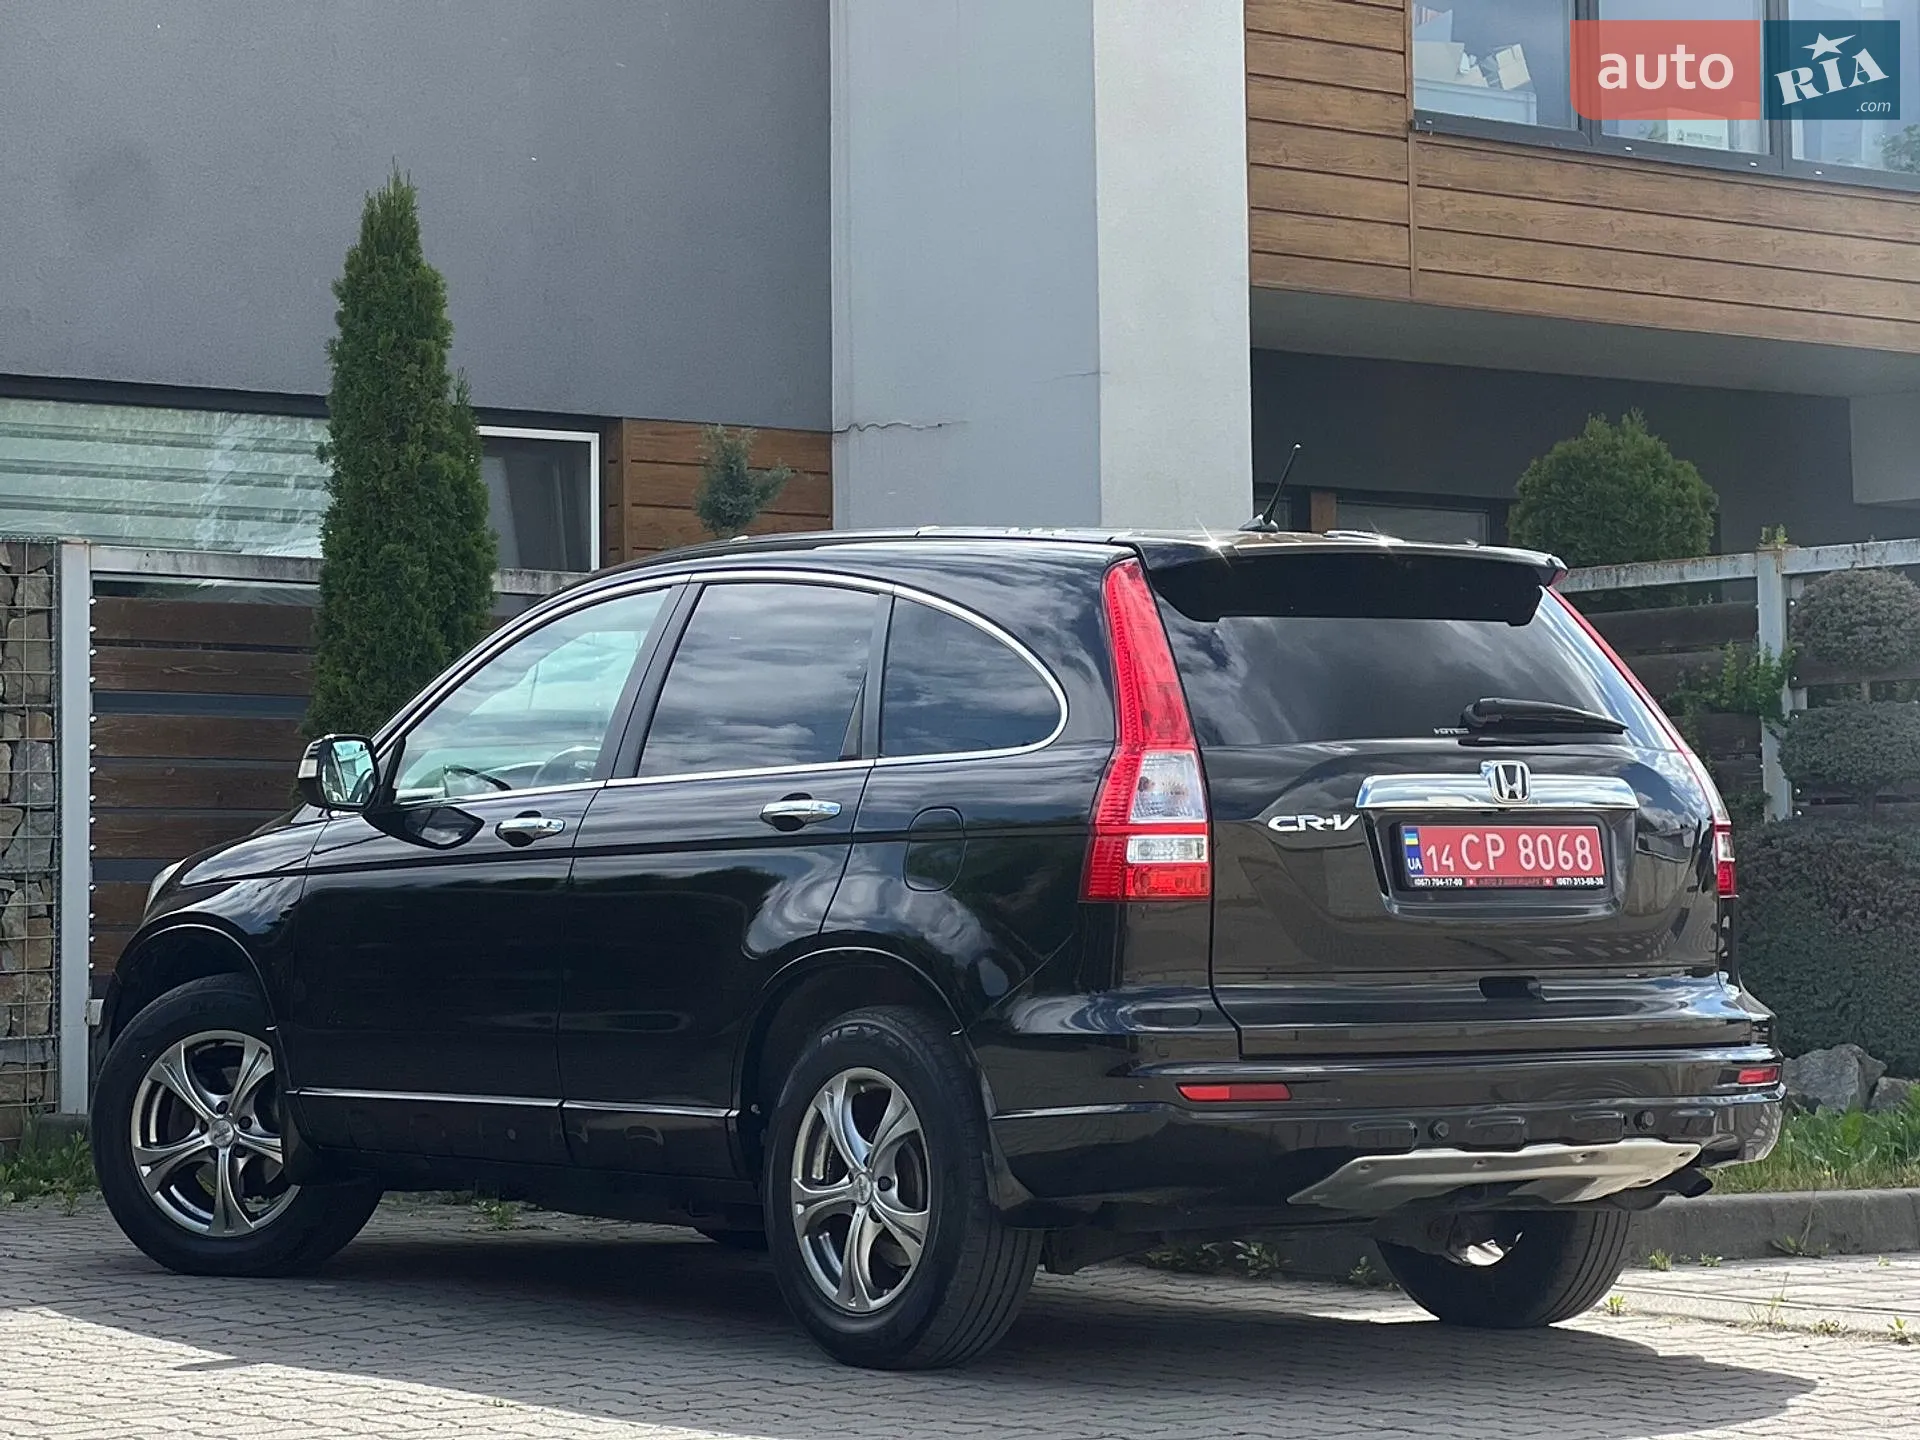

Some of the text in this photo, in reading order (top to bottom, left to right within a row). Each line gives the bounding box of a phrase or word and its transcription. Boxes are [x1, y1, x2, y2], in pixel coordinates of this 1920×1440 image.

[1267, 814, 1360, 832] CR-V
[1426, 832, 1594, 873] 14 CP 8068
[1406, 857, 1423, 871] UA
